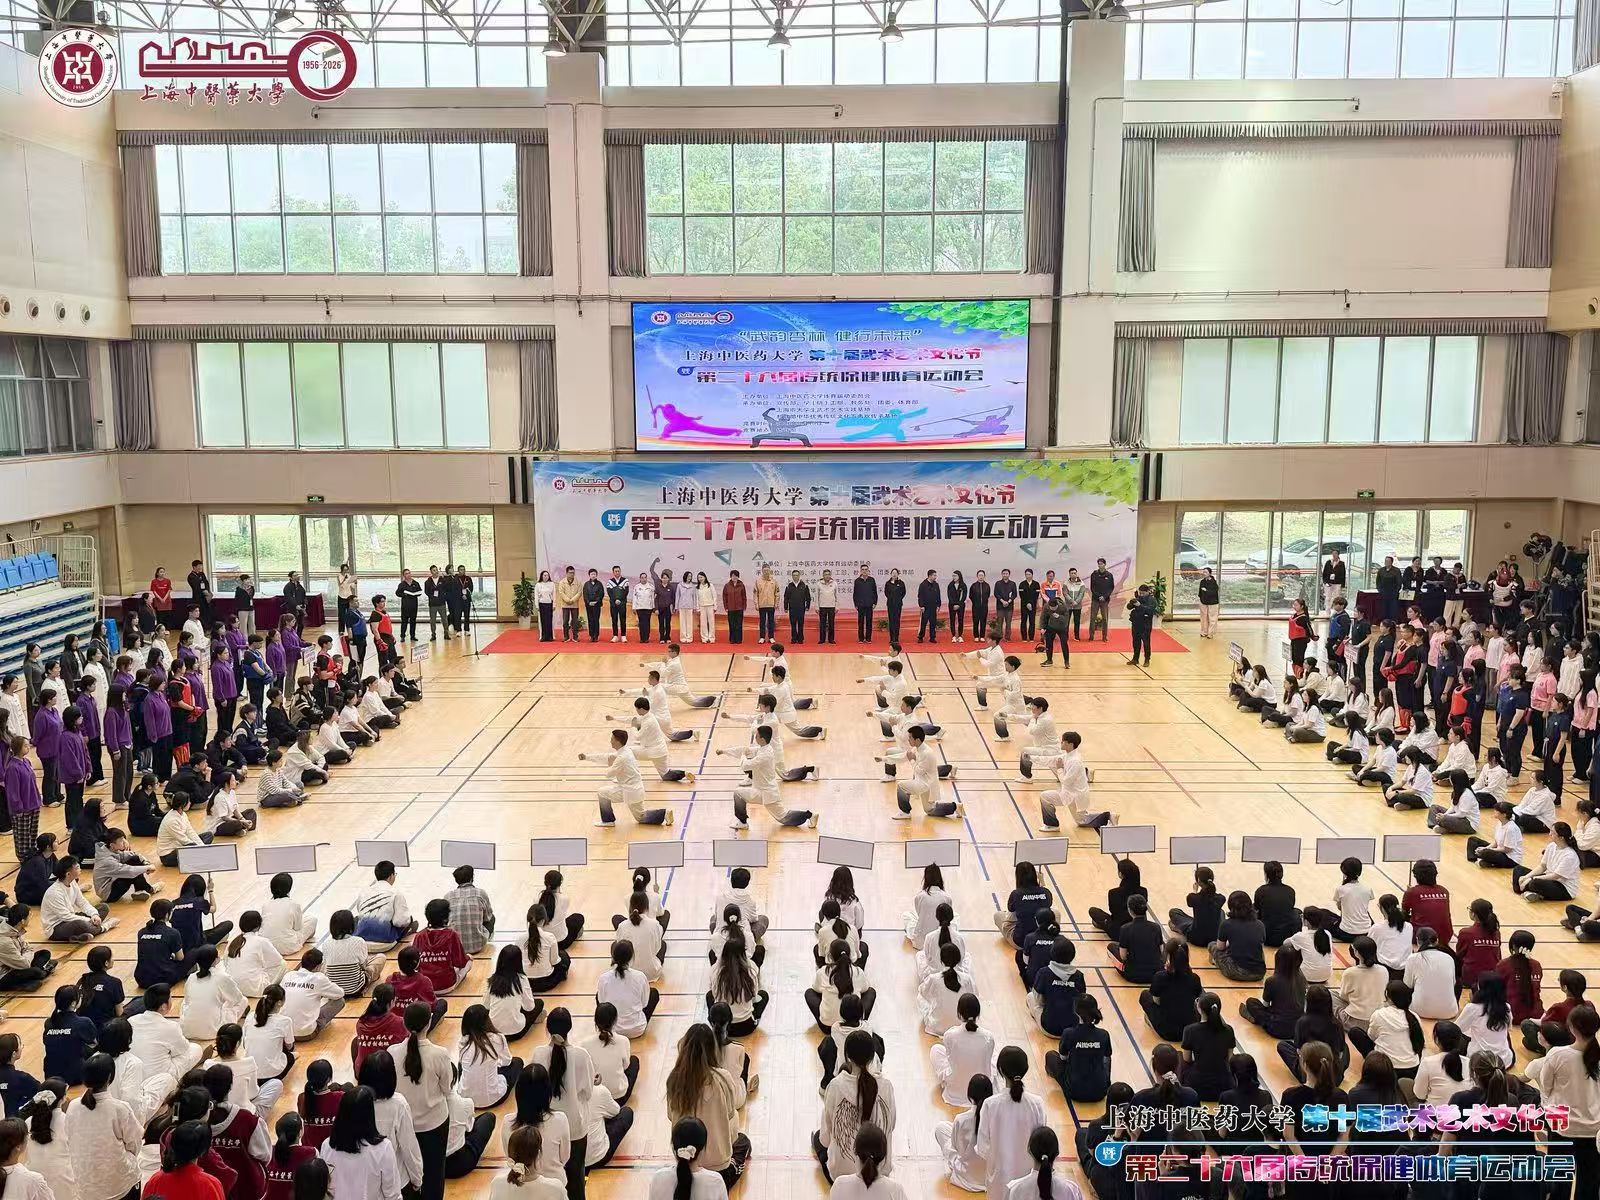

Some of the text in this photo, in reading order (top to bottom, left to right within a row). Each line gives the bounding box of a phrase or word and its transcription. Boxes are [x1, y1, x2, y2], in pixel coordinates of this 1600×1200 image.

[680, 349, 983, 362] 上海中医药大学 第十届武术艺术文化节
[697, 369, 984, 383] 第二十六届传统保健体育运动会
[656, 484, 1016, 507] 上海中医药大学 第十届武术艺术文化节
[631, 515, 1070, 541] 第二十六届传统保健体育运动会
